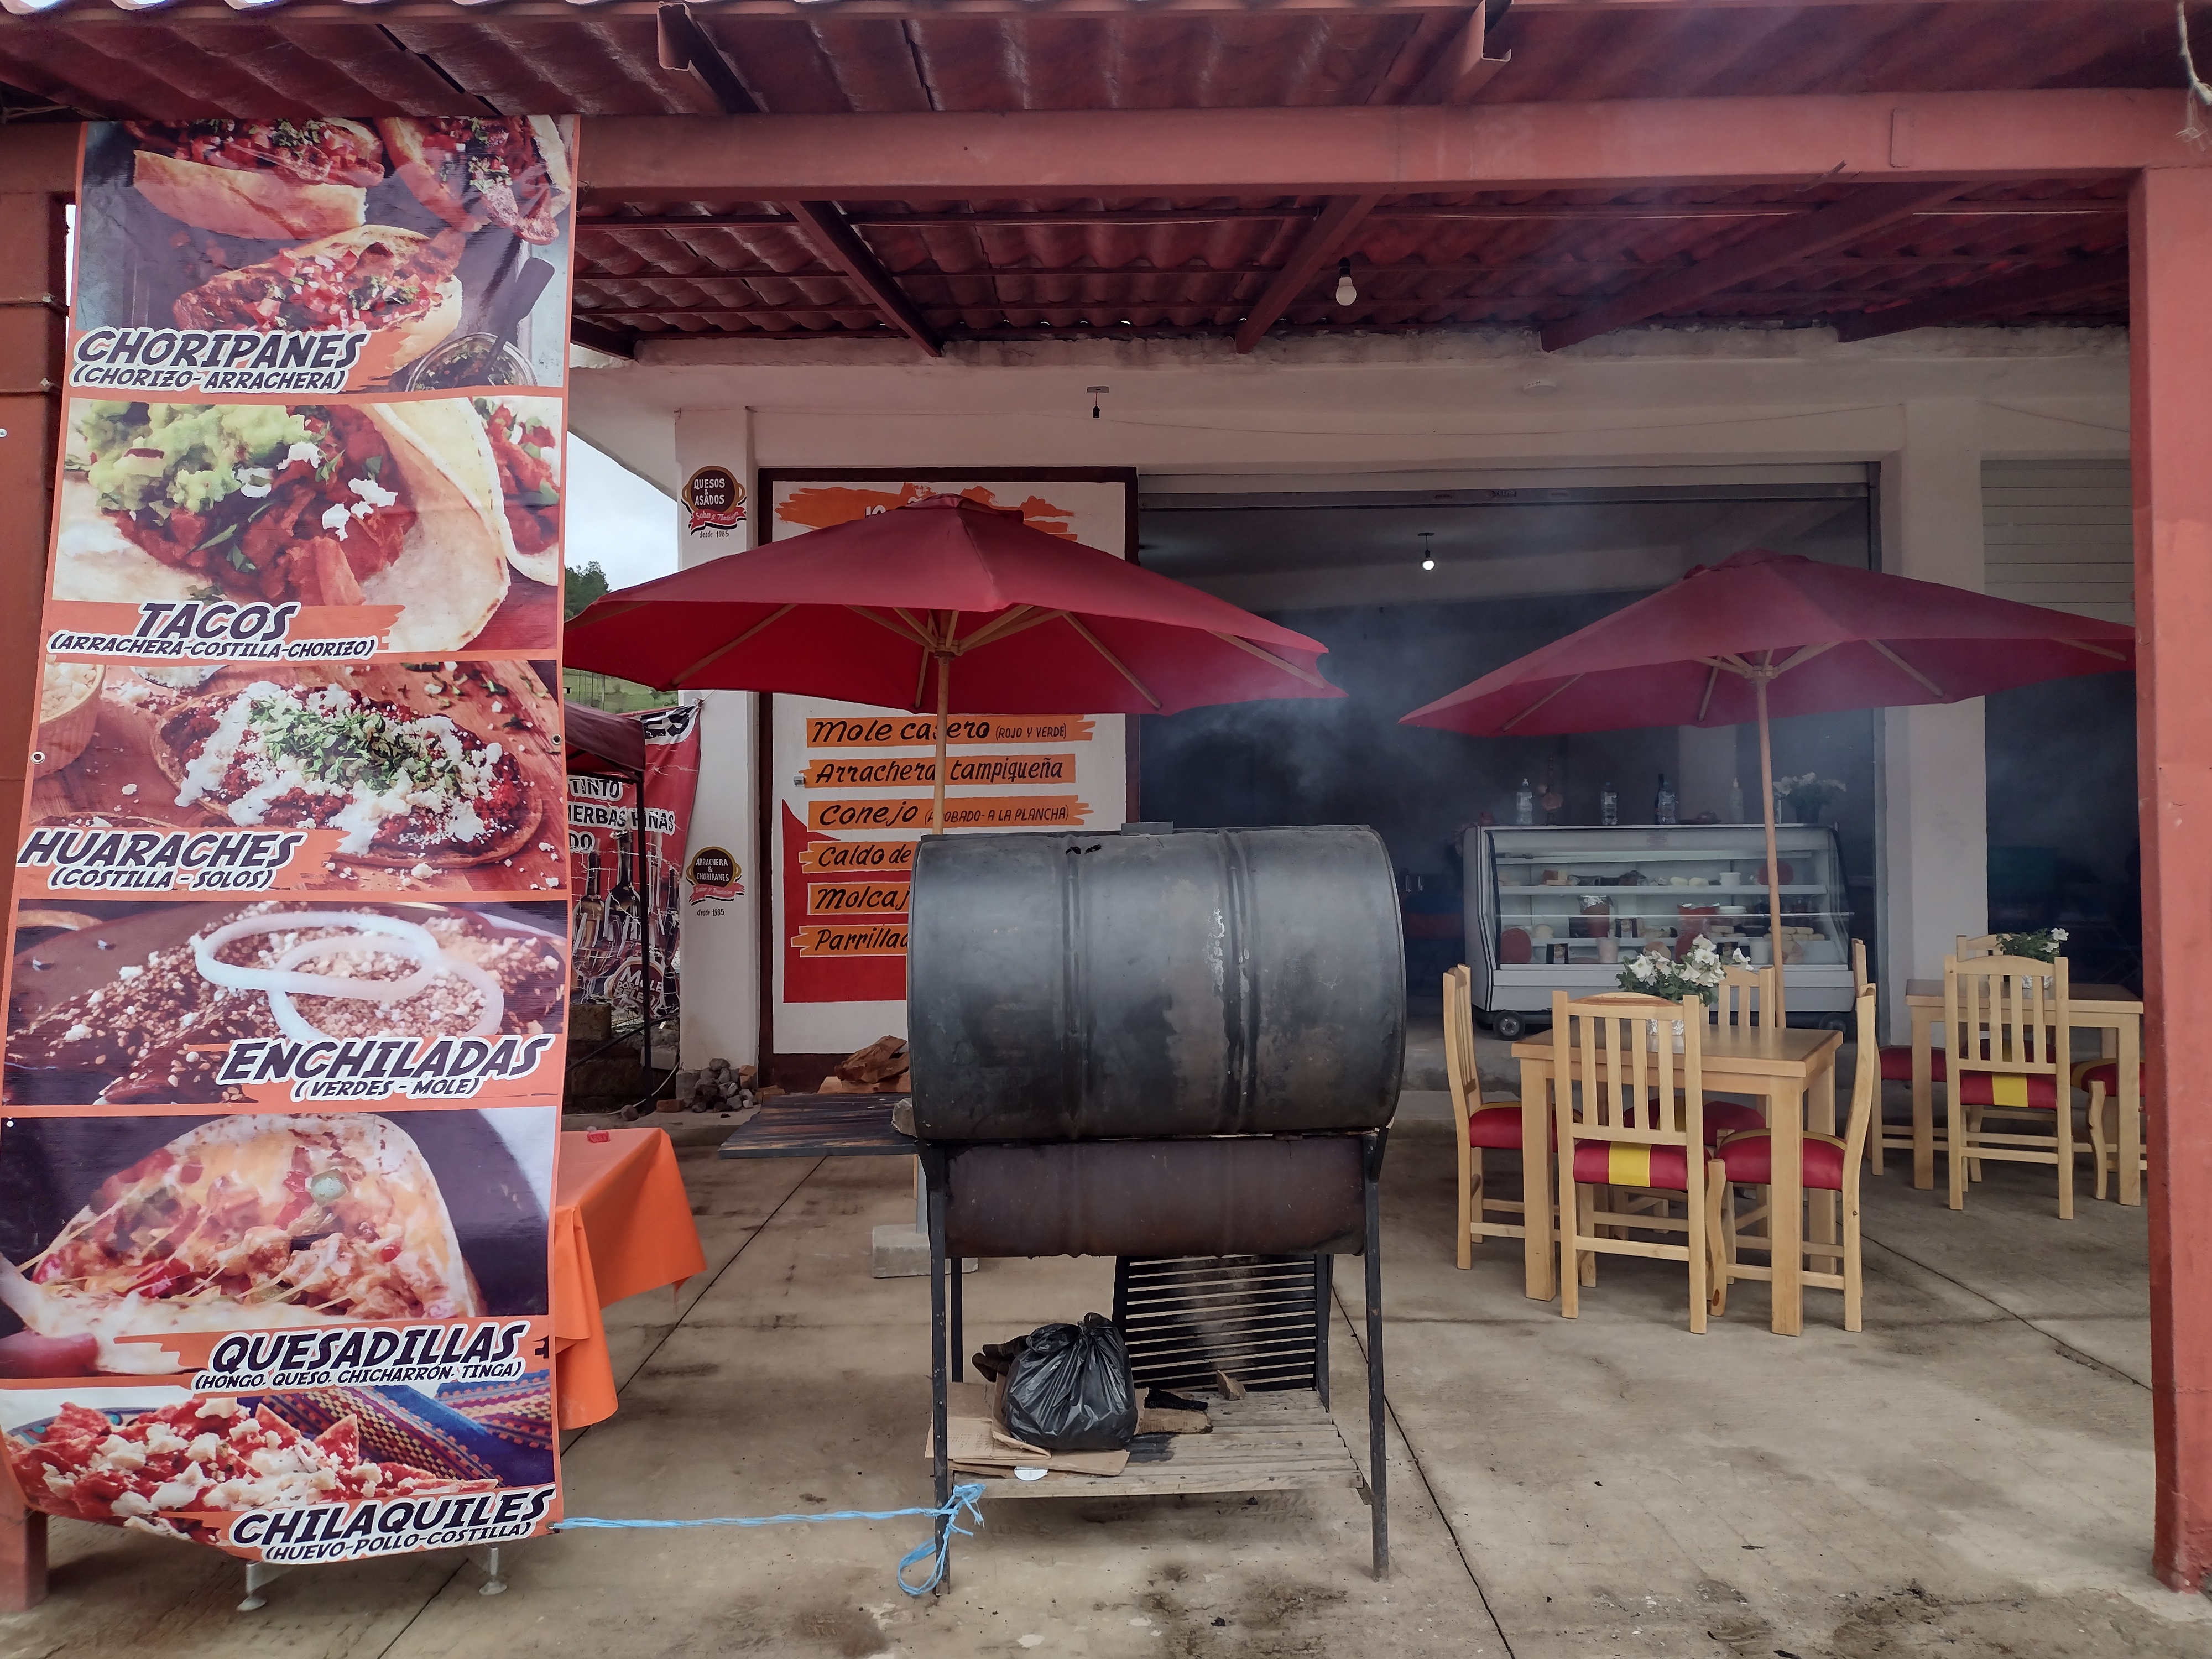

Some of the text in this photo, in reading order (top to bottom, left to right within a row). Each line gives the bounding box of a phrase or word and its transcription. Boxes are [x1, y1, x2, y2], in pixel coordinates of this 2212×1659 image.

[76, 330, 367, 369] CHORIPANES
[694, 478, 725, 489] QUESOS
[695, 495, 724, 505] ASADOS
[137, 603, 300, 639] TACOS
[50, 633, 375, 658] (ARRACHERA-COSTILLA-CHORIZO)
[812, 720, 892, 743] Mole
[996, 725, 1022, 740] (ROJO
[1027, 727, 1033, 738] Y
[1036, 723, 1066, 739] VERDE)
[815, 758, 1063, 784] Arrachera tampiqueña
[569, 778, 620, 799] TINTO
[820, 801, 919, 826] Conejo
[987, 809, 995, 821] A
[998, 809, 1011, 821] LA
[1014, 804, 1070, 822] PLANCHA)
[17, 831, 304, 868] HUARACHES
[818, 844, 912, 867] Caldo de
[52, 867, 174, 888] (COSTILLA
[194, 870, 273, 888] SOLOS)
[221, 1039, 552, 1080] ENCHILADAS
[411, 1078, 480, 1095] MOLE)
[212, 1324, 525, 1374] QUESADILLAS
[461, 1361, 521, 1379] TINGA)
[233, 1488, 556, 1546] CHILAQUILES
[265, 1521, 532, 1561] (HUEVO-POLLO-COSTILLA)
